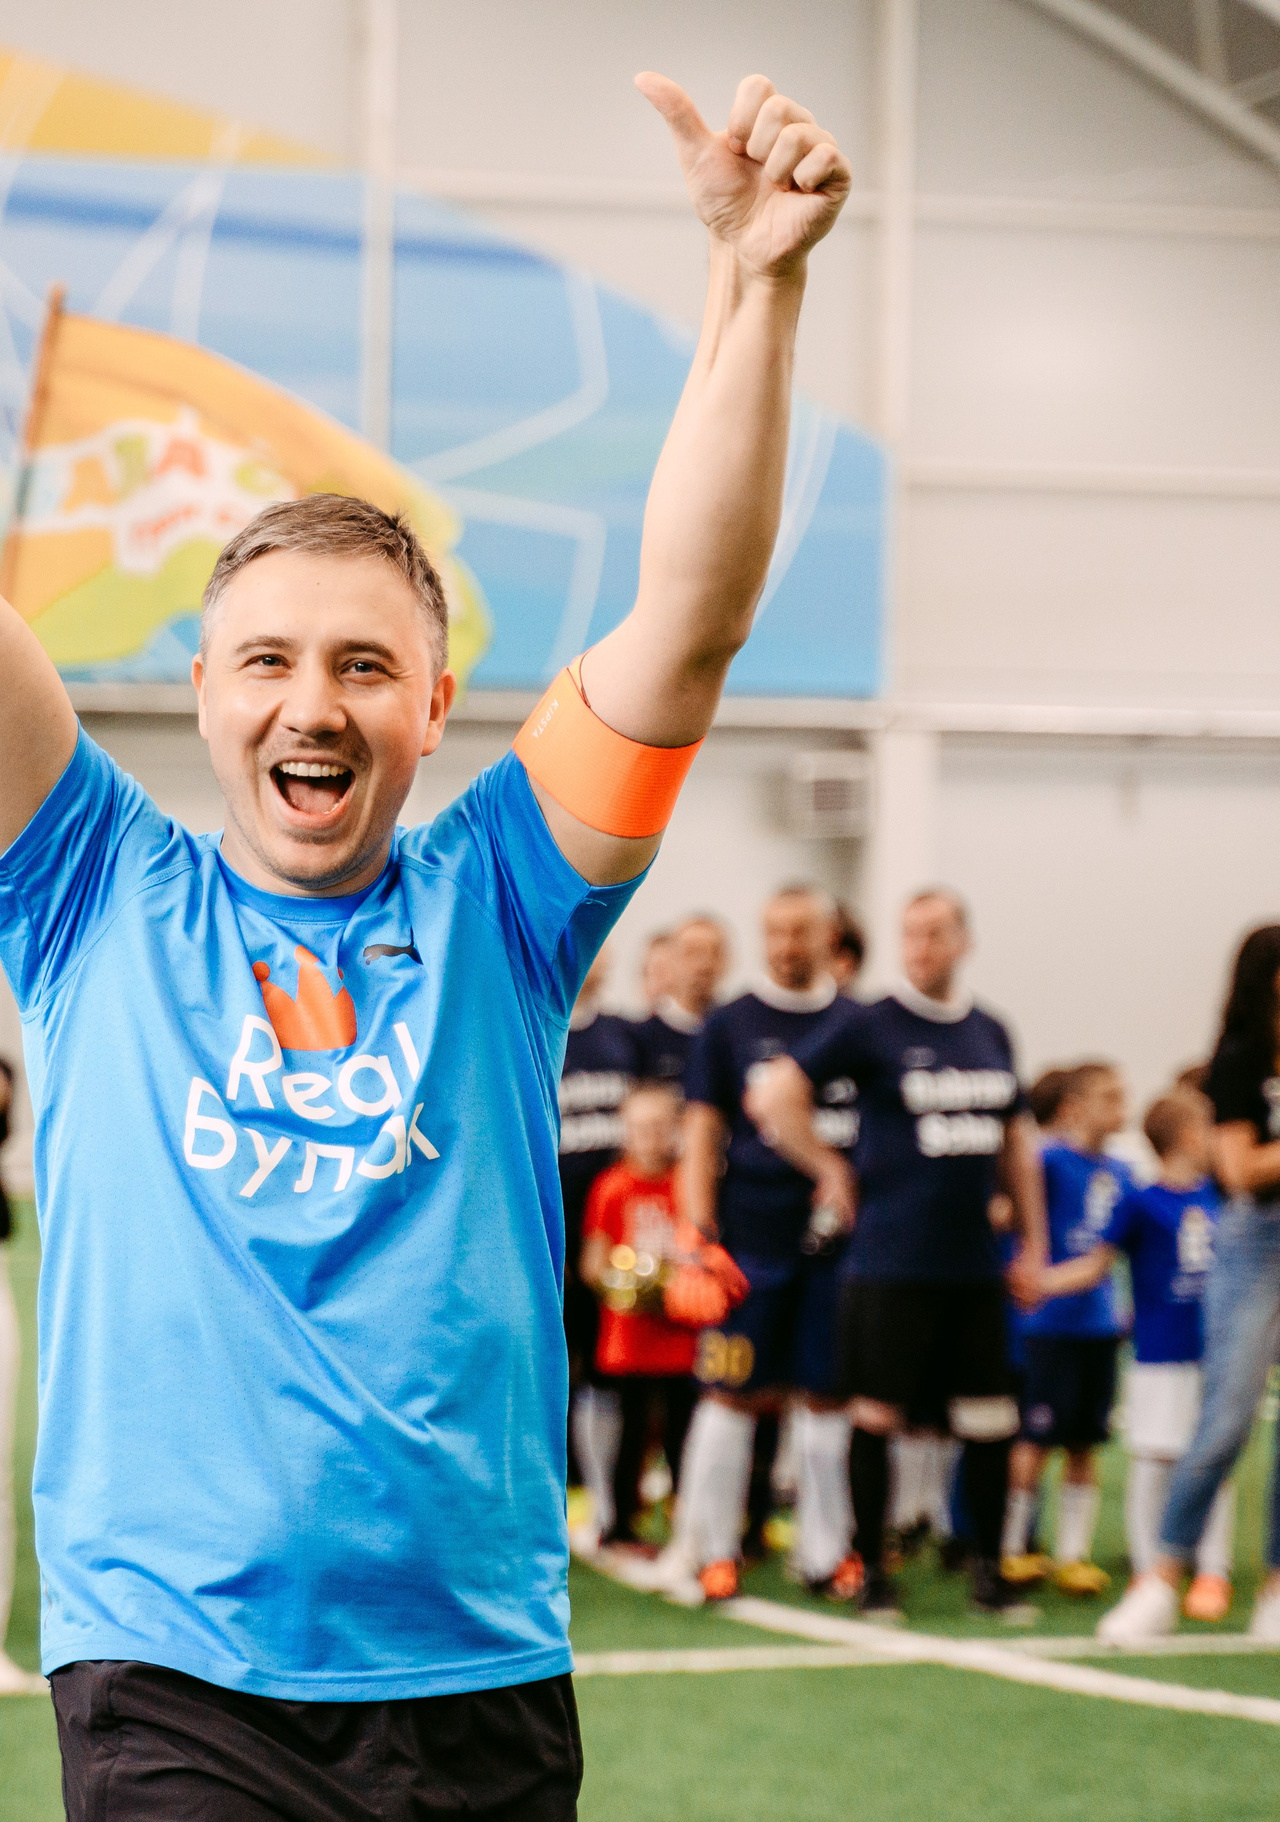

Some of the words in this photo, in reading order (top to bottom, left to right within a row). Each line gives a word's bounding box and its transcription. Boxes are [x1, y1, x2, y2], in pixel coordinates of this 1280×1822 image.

[532, 698, 560, 739] KIPSTA
[226, 1013, 421, 1120] Real
[182, 1076, 441, 1198] Булак
